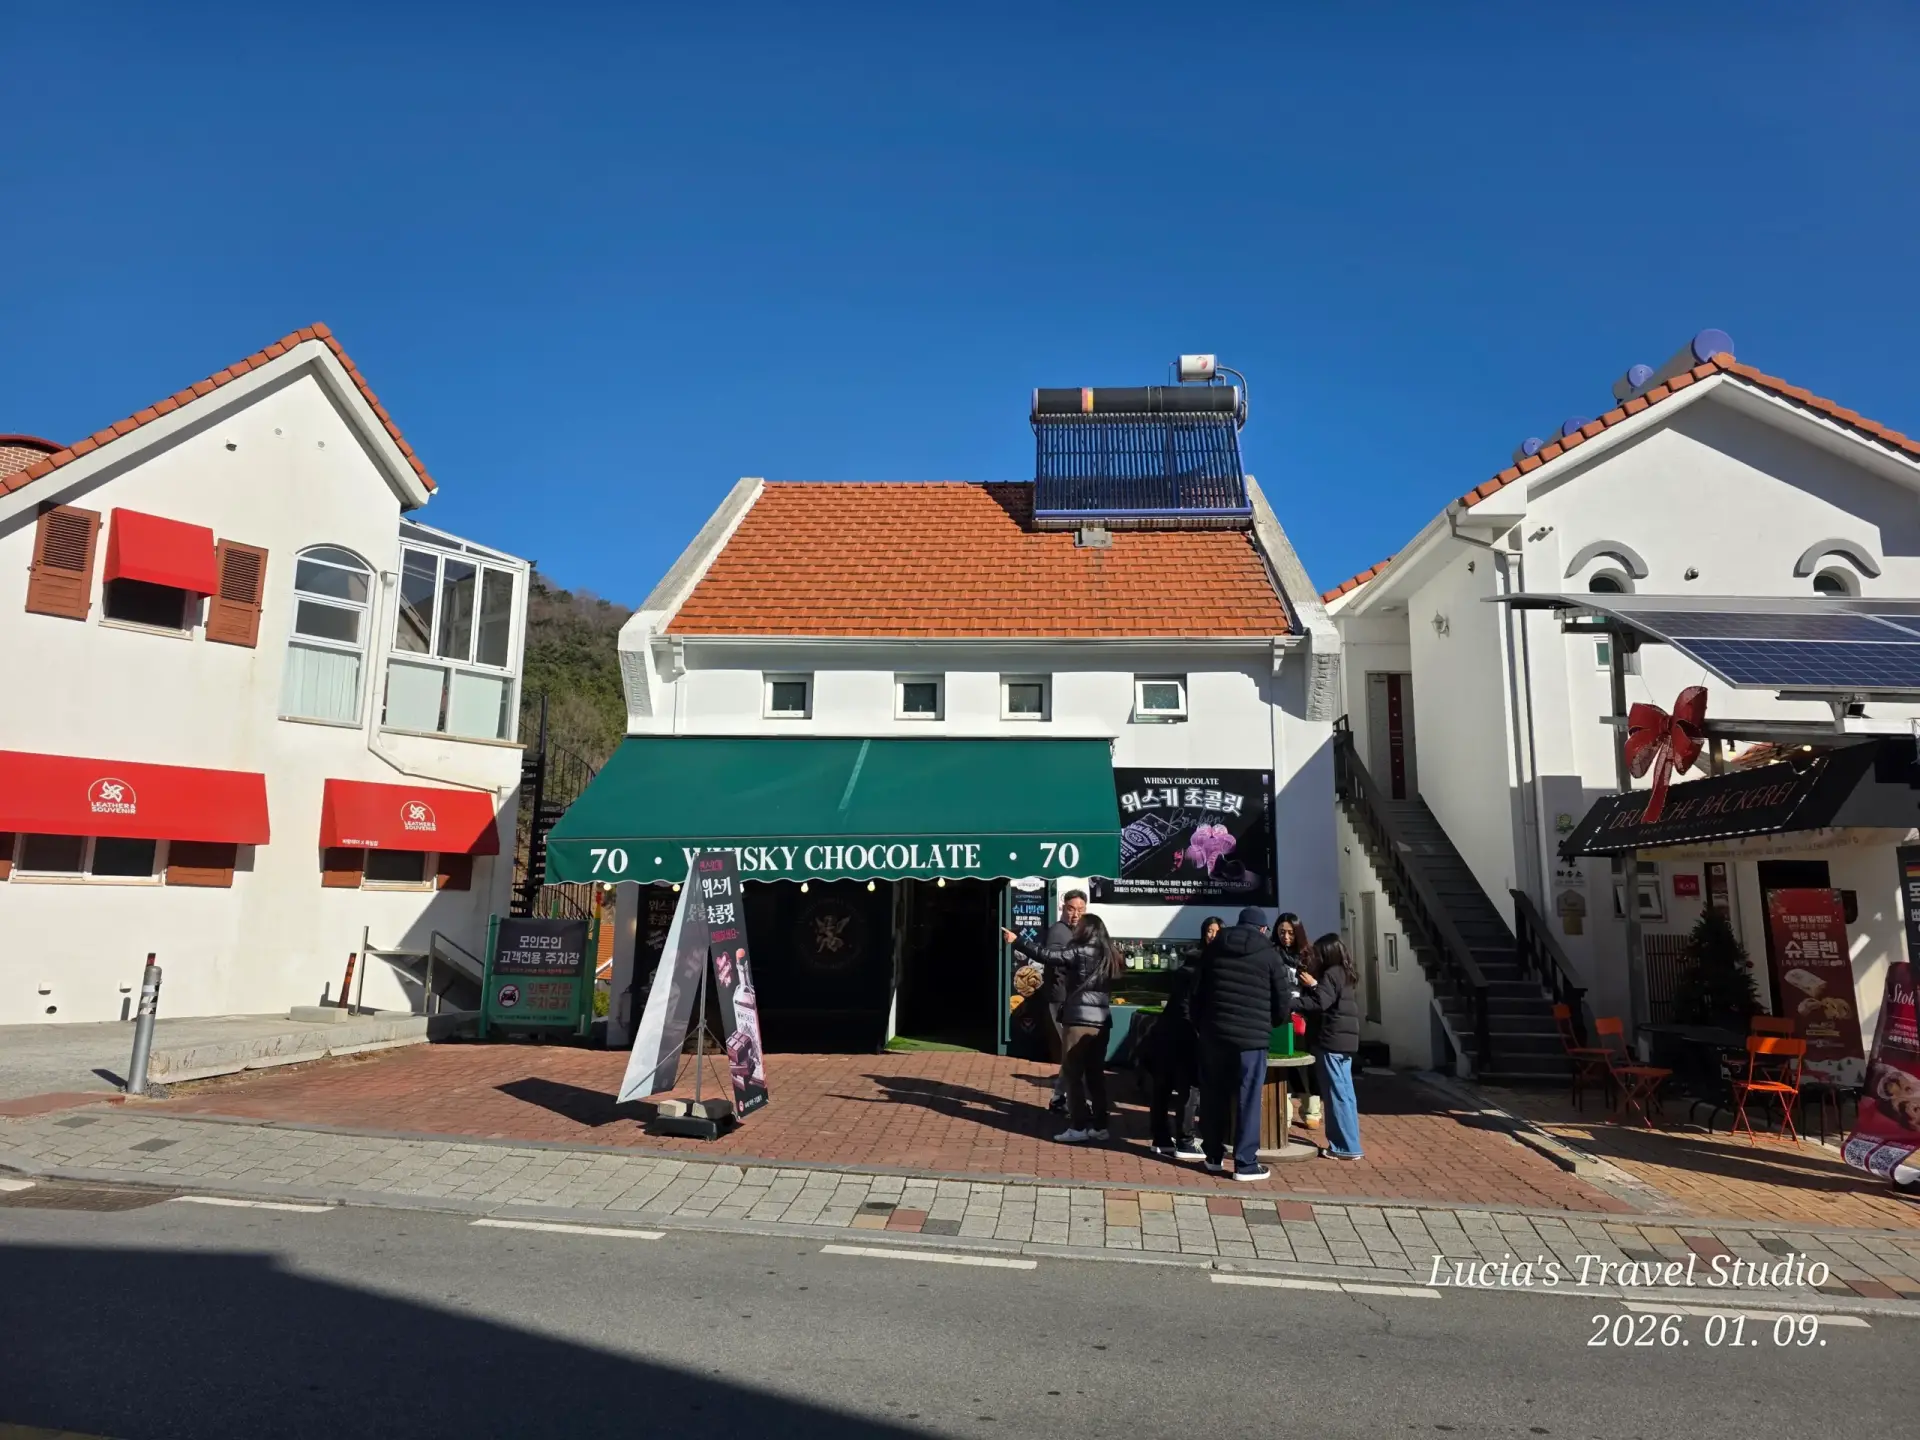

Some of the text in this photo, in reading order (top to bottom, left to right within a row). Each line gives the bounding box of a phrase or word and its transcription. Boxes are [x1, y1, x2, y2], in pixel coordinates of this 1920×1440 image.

[1144, 777, 1219, 785] WHISKY CHOCOLATE
[1121, 787, 1179, 813] 위스키
[1184, 787, 1245, 817] 초콜릿
[1698, 781, 1800, 816] BÄCKEREI
[91, 806, 136, 815] SOUVENIR
[590, 848, 629, 874] 70
[804, 844, 981, 871] CHOCOLATE
[1040, 842, 1080, 869] 70
[702, 876, 732, 898] 위스키
[707, 902, 735, 925] 초콜릿
[519, 935, 562, 949] 모인모인
[500, 950, 580, 966] 고객전용 주차장
[527, 981, 572, 997] 외부차량
[526, 996, 570, 1010] 주차금지
